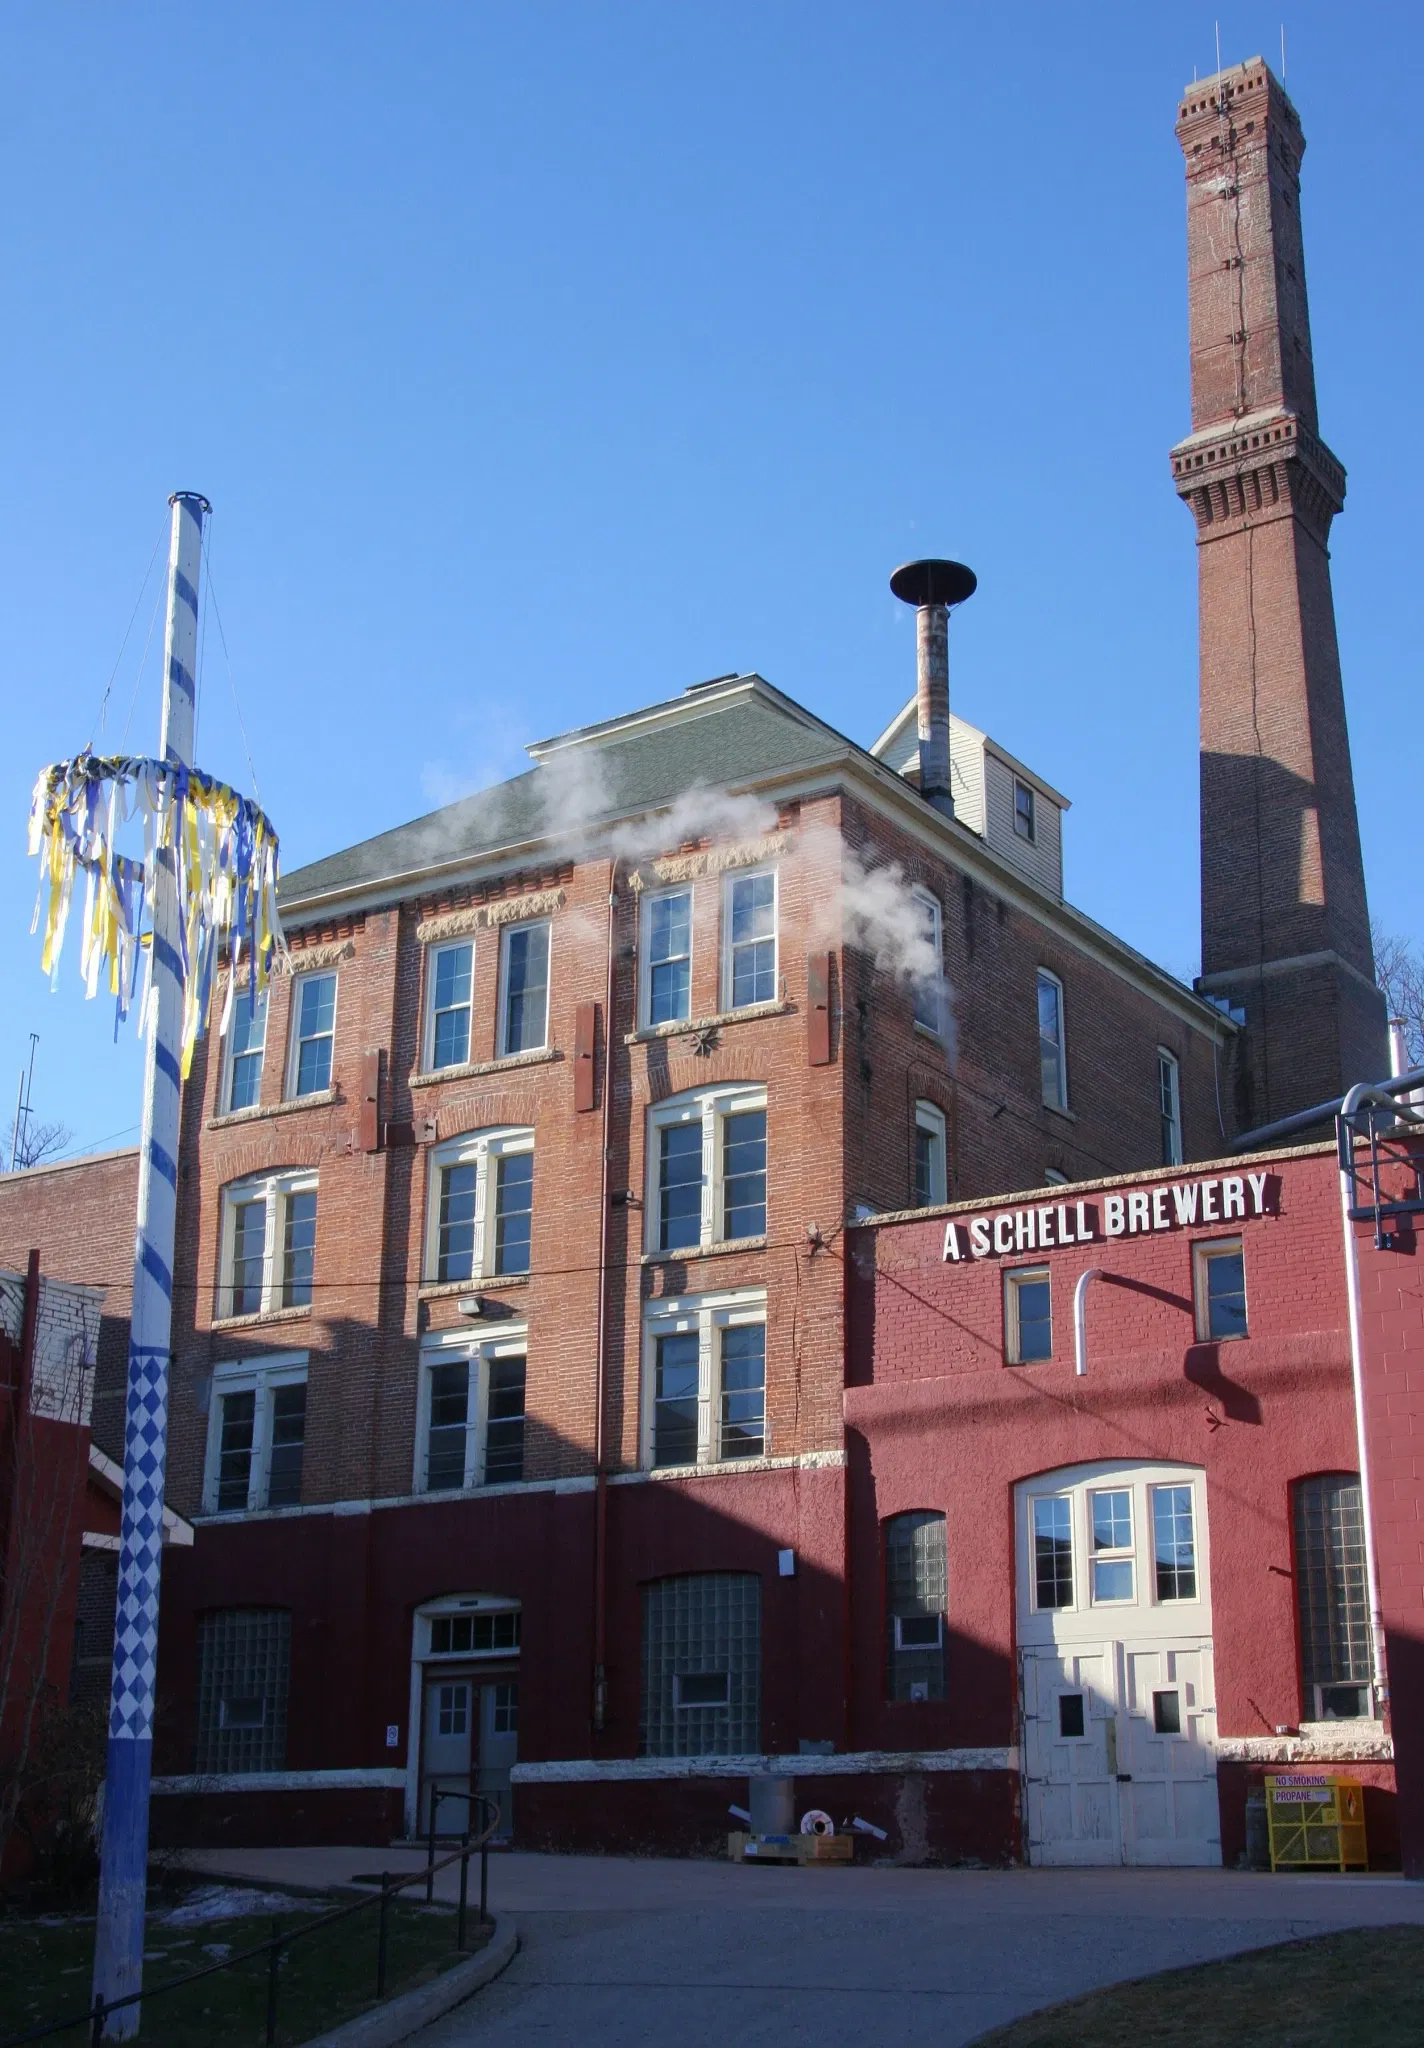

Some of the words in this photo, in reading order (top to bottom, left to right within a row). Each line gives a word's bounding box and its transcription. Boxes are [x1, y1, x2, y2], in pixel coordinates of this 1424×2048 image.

[1275, 1776, 1287, 1786] NO
[1288, 1775, 1326, 1786] SMOKING
[1275, 1791, 1312, 1801] PROPANE
